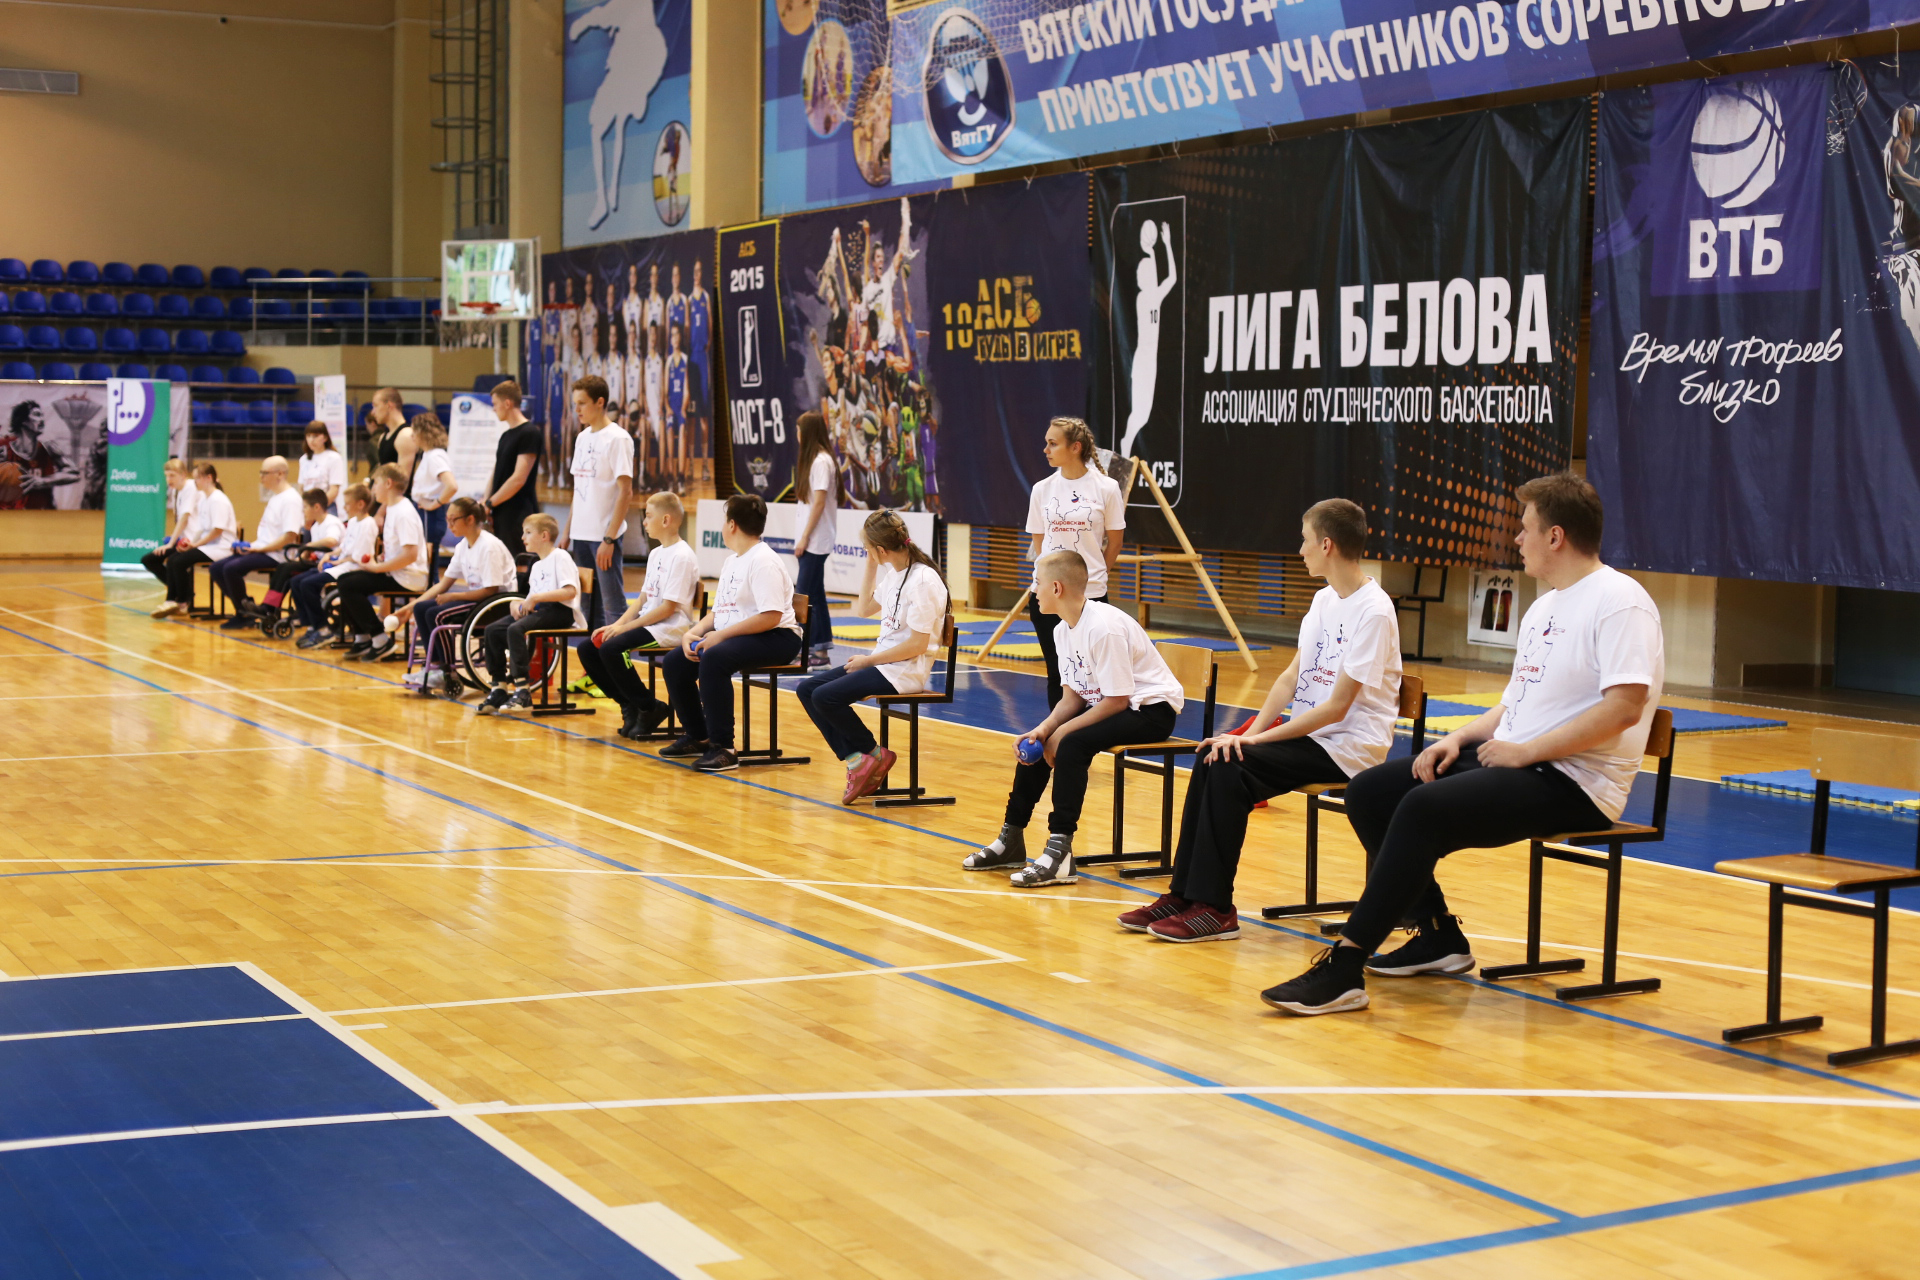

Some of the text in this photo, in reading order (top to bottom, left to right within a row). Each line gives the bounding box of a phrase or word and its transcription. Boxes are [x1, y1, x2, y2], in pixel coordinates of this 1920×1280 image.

[1019, 0, 1157, 63] ВЯТСКИЙ
[1038, 49, 1257, 133] ПРИВЕТСТВУЕТ
[1257, 1, 1509, 93] УЧАСТНИКОВ
[951, 124, 997, 148] ВятГУ
[1688, 214, 1784, 279] ВТБ
[730, 266, 764, 292] 2015
[974, 275, 1041, 330] АСБ
[942, 302, 973, 350] 10
[1150, 309, 1158, 323] 10
[1204, 274, 1553, 373] ЛИГА БЕЛОВА
[1015, 331, 1031, 361] В
[1034, 329, 1081, 361] ИГРЕ
[1620, 328, 1843, 383] Время трофеев
[1202, 385, 1553, 426] АССОЦИАЦИЯ СТУДЕНЧЕСКОГО БАСКЕТБОЛА
[1679, 370, 1780, 423] близко
[110, 469, 137, 480] Добро
